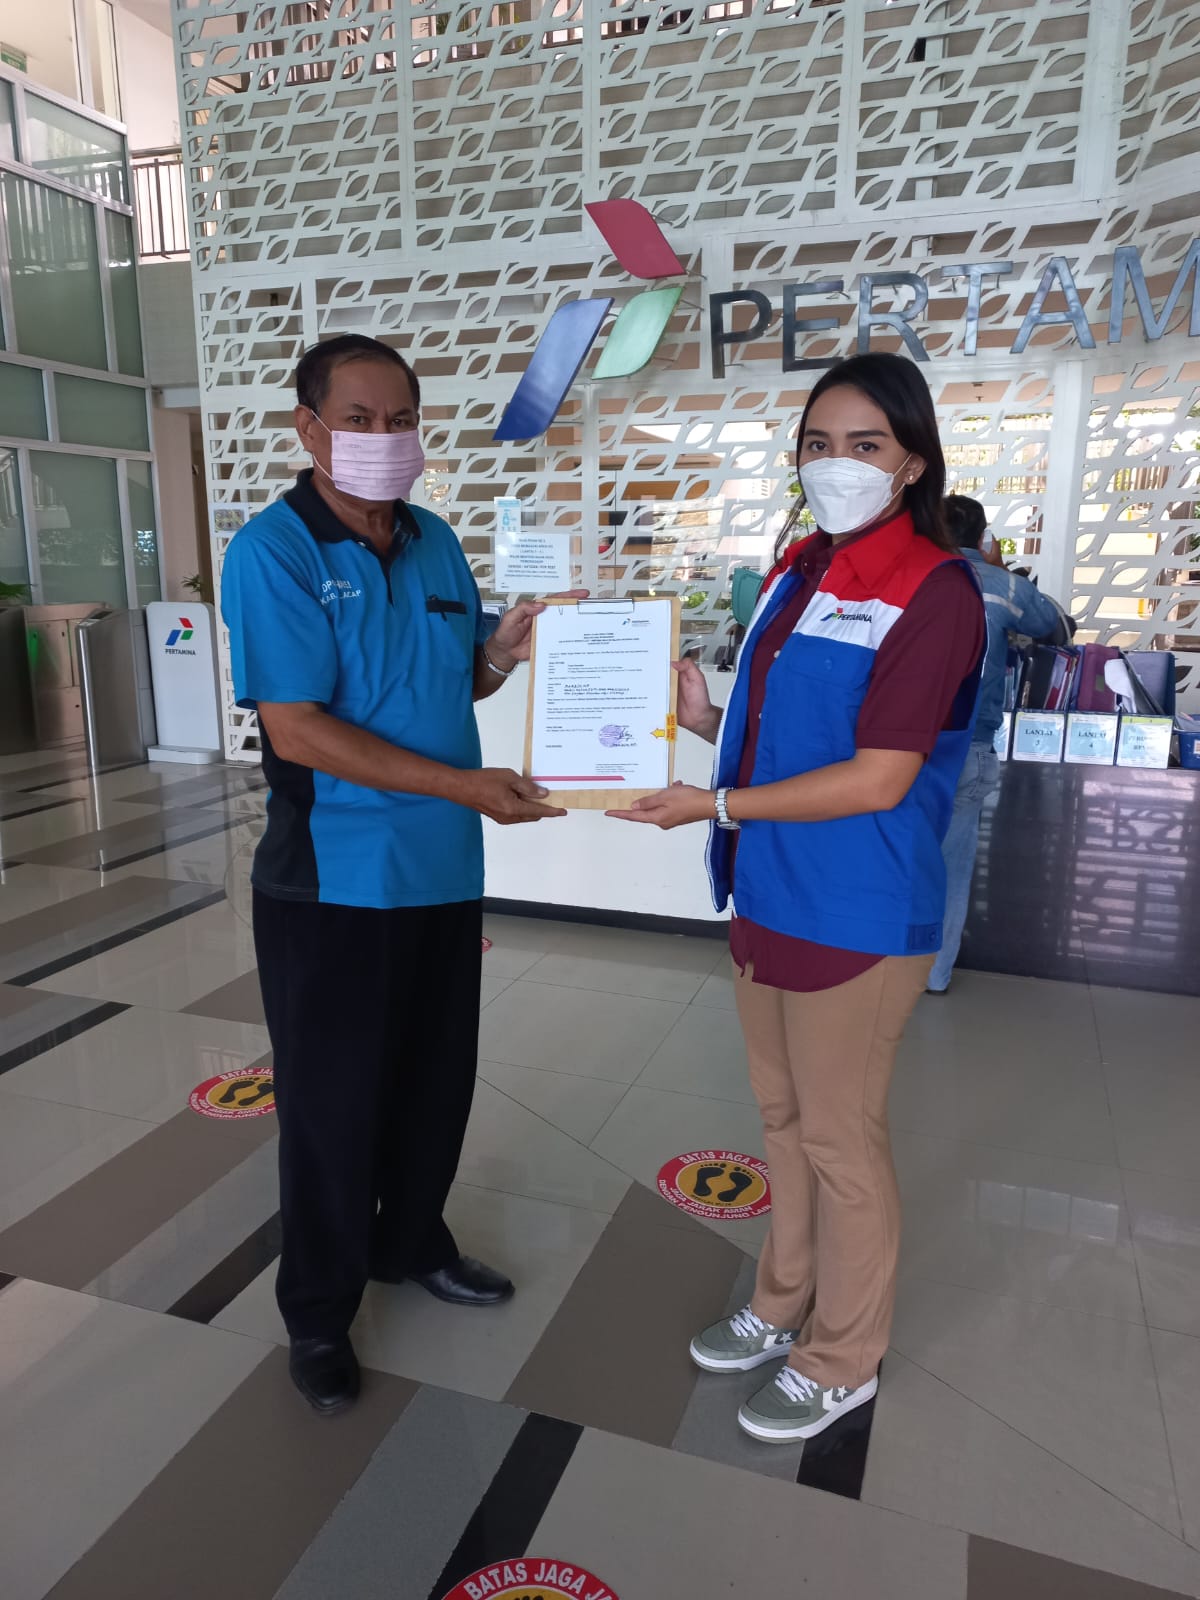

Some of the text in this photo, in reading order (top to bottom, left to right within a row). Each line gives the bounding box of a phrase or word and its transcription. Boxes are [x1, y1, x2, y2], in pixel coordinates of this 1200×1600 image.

[837, 613, 873, 624] PERTAMINA
[165, 648, 196, 656] PERTAMINA
[219, 1068, 254, 1080] BATAS
[678, 1151, 716, 1165] BATAS
[719, 1151, 751, 1165] JAGA
[658, 1179, 680, 1204] DENGAN
[678, 1202, 750, 1219] PENGUNJUNG
[670, 1187, 687, 1202] JAGA
[687, 1201, 721, 1214] JARAK
[723, 1205, 753, 1214] AMAN
[463, 1562, 528, 1600] BATAS
[534, 1562, 587, 1594] JAGA
